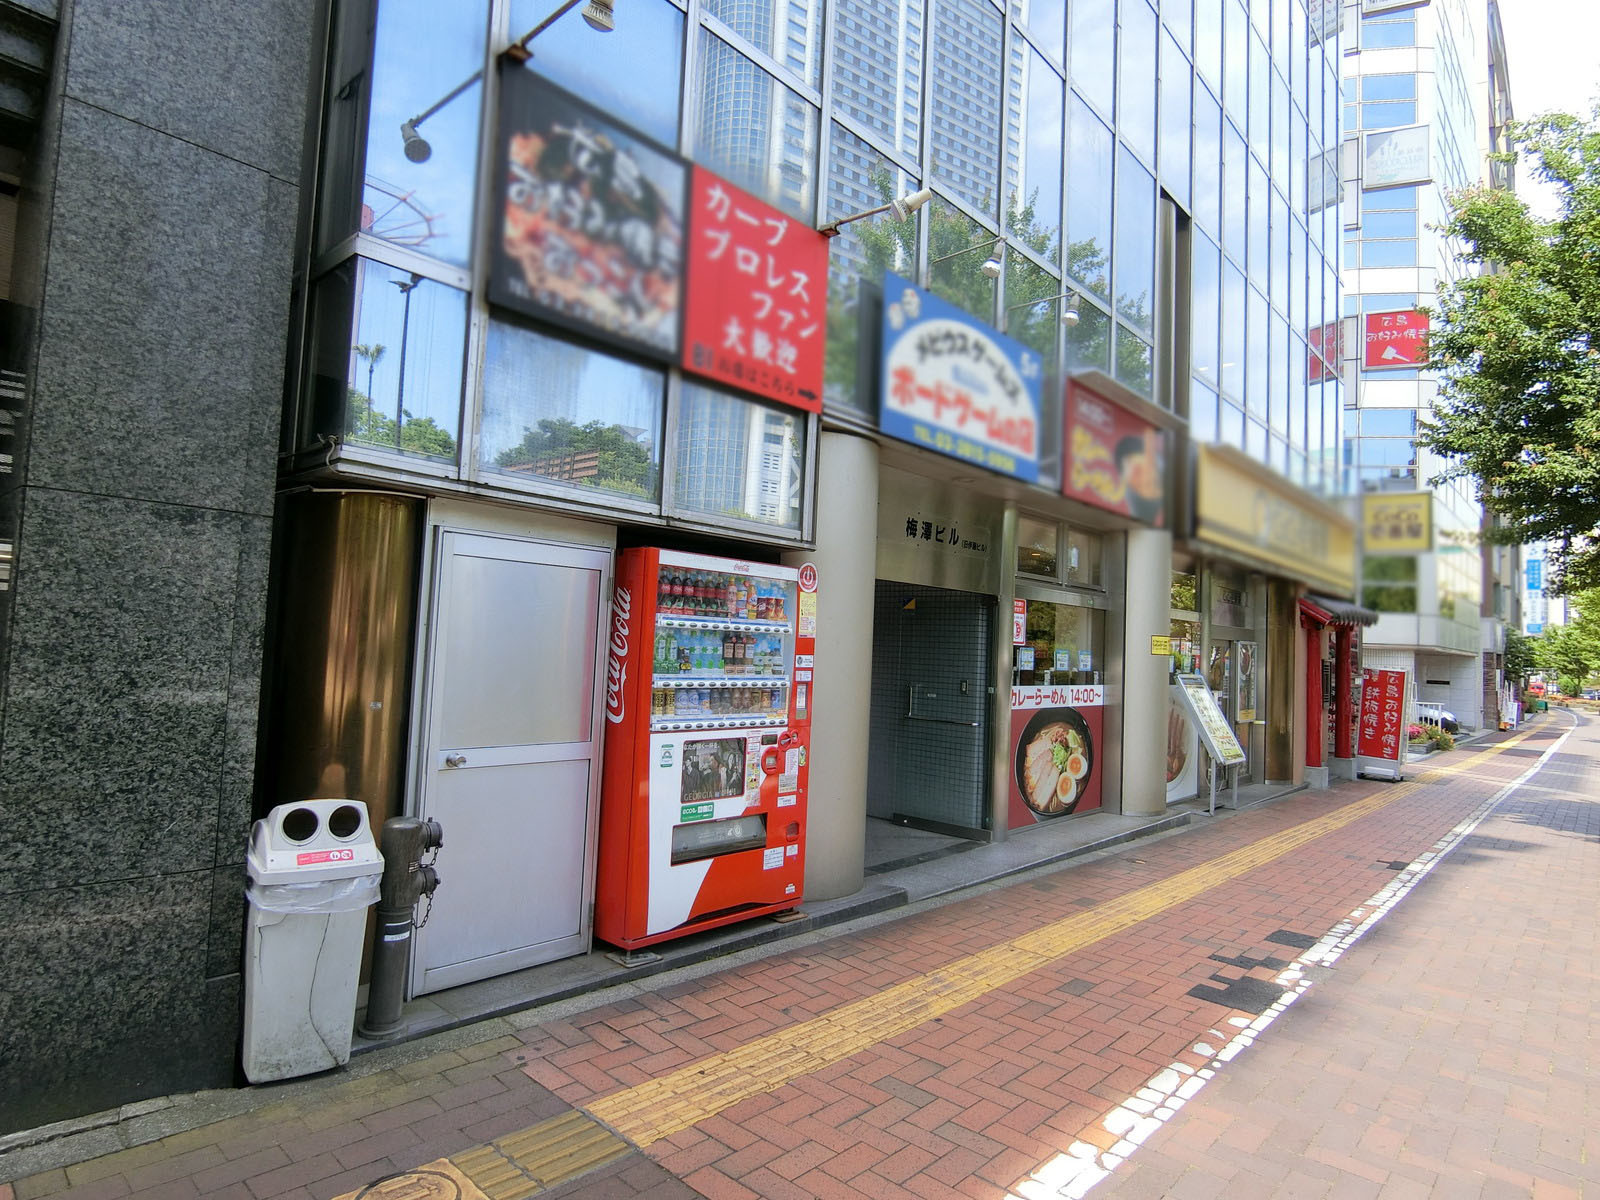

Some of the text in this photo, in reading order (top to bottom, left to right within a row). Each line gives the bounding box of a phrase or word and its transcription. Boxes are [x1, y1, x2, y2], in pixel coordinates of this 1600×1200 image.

[705, 183, 789, 247] カープ
[704, 229, 810, 303] プロレス
[752, 291, 818, 338] ファン
[1381, 314, 1408, 327] 広島
[1367, 328, 1427, 342] お好み焼き
[905, 516, 960, 546] 梅澤ビル
[1011, 688, 1067, 706] カレーらーめん
[1363, 686, 1381, 740] 鉄板焼き
